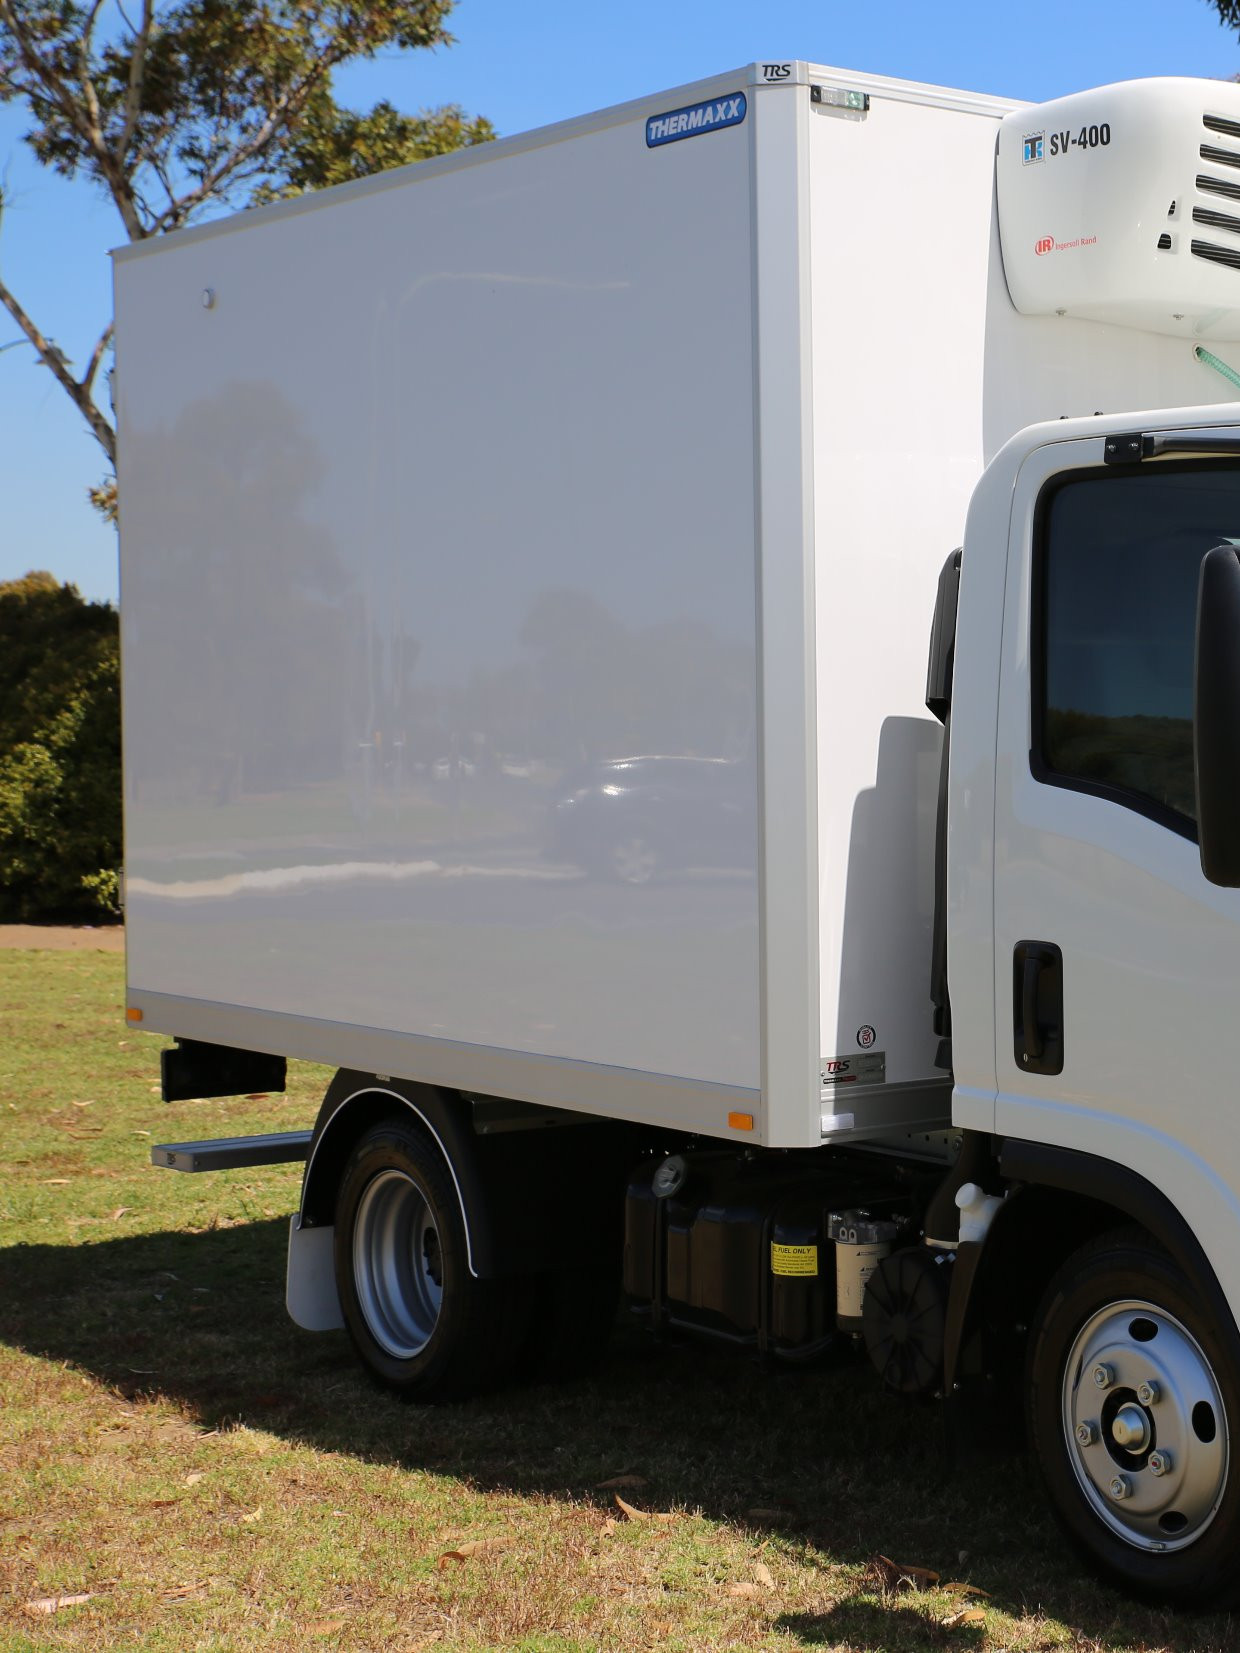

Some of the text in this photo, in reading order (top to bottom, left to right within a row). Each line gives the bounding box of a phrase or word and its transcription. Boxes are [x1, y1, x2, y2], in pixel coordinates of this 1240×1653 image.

[761, 64, 791, 79] TRS
[649, 98, 742, 140] THERMAXX
[1050, 123, 1111, 156] SV-400
[1080, 236, 1097, 246] Rand
[826, 1060, 851, 1072] TRS
[792, 1247, 811, 1255] ONLY
